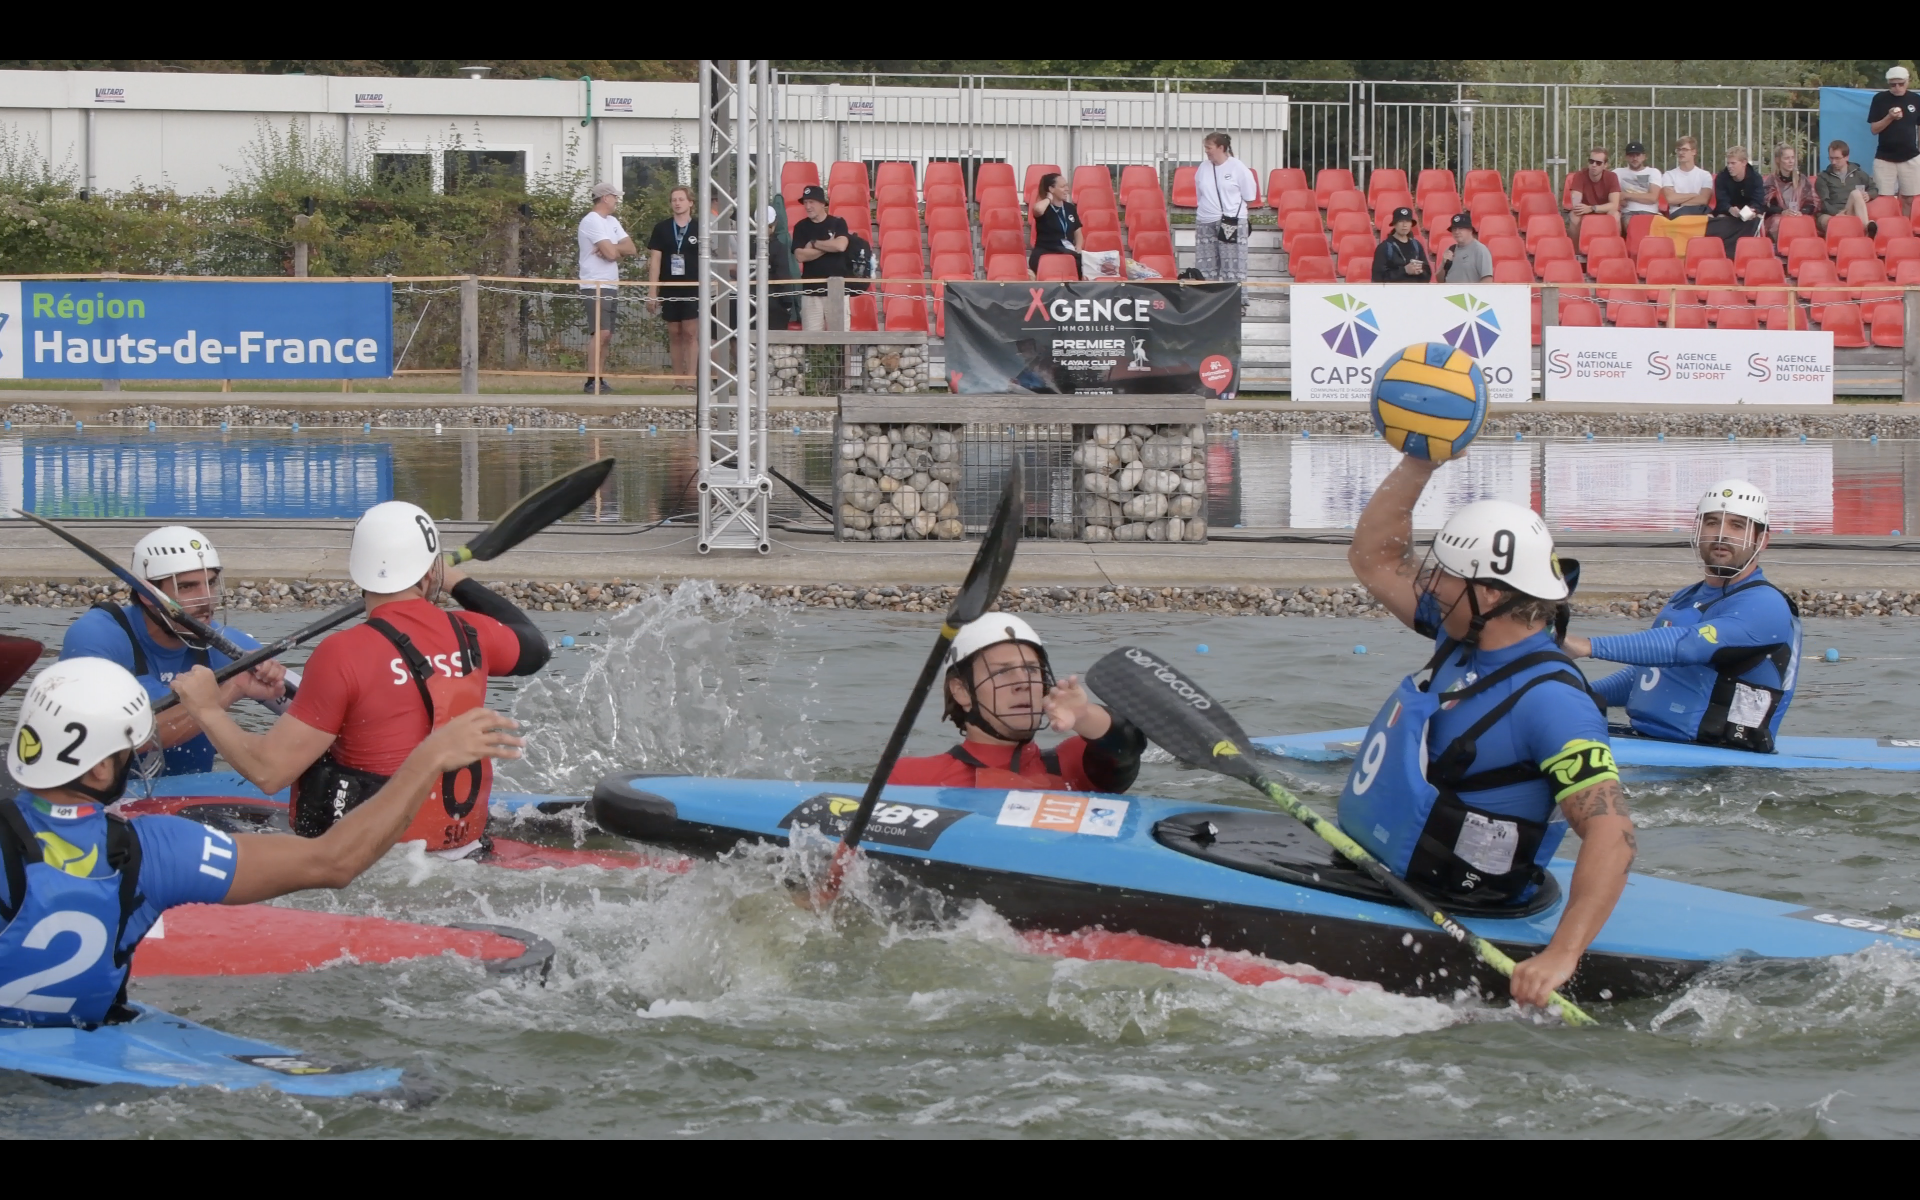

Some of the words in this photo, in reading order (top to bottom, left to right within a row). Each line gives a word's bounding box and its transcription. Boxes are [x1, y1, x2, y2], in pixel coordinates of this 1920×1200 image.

[33, 293, 145, 325] Région
[1153, 300, 1165, 310] 53
[34, 330, 378, 364] Hauts-de-France
[1052, 339, 1126, 349] PREMIER
[1052, 349, 1126, 357] SUPPORTER
[1577, 351, 1618, 359] AGENCE
[1676, 353, 1717, 361] AGENCE
[1776, 355, 1817, 363] AGENCE
[1576, 361, 1633, 369] NATIONALE
[1676, 362, 1732, 371] NATIONALE
[1776, 364, 1832, 373] NATIONALE
[1310, 366, 1373, 385] CAPS
[1576, 370, 1591, 378] DU
[1593, 370, 1627, 378] SPORT
[1676, 372, 1690, 380] DU
[1692, 372, 1726, 380] SPORT
[1776, 373, 1790, 381] DU
[1792, 373, 1826, 382] SPORT
[415, 514, 437, 553] 6
[1490, 529, 1516, 575] 9
[56, 721, 88, 767] 2
[1352, 731, 1387, 796] 9
[1038, 799, 1081, 824] ITA
[0, 910, 108, 1014] 2
